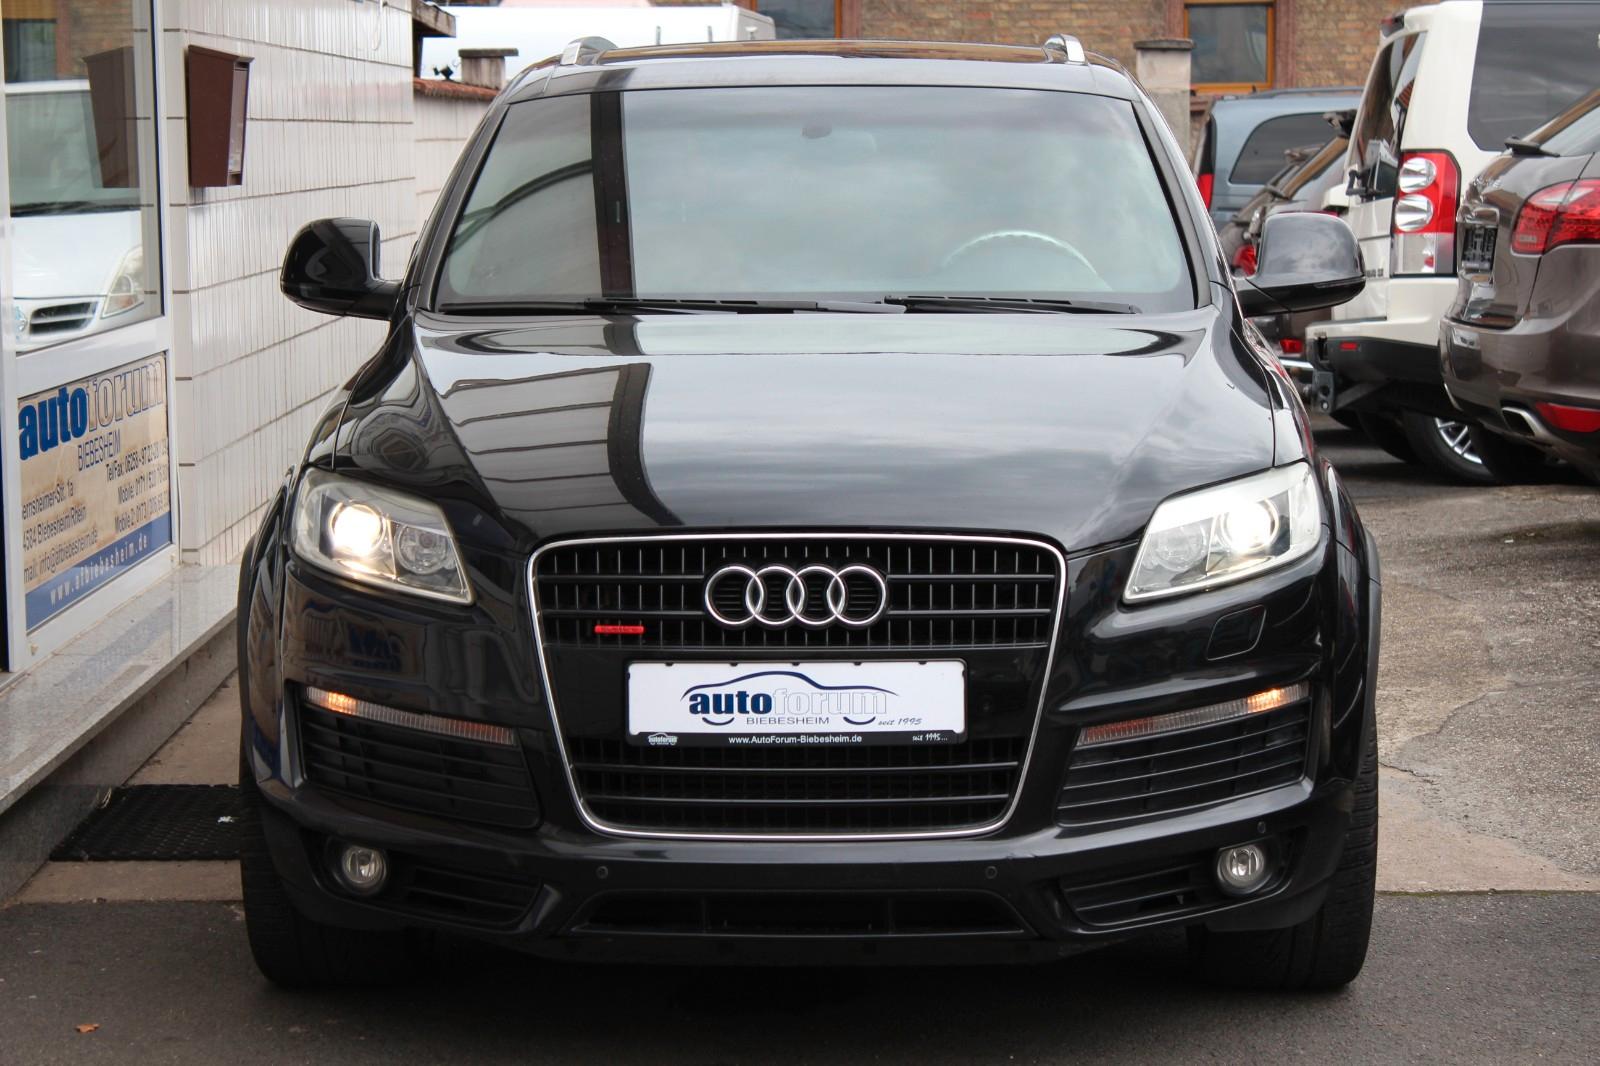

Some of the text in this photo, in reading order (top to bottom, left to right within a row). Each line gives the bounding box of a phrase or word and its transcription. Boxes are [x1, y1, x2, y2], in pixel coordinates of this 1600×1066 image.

[18, 360, 164, 460] autoforum
[77, 429, 120, 471] BIEBESHEIM
[51, 533, 147, 608] www.afbiebesheim.de
[689, 688, 887, 715] autoforum
[746, 717, 829, 725] BIEBESHEIM
[898, 717, 922, 725] 1995
[728, 734, 863, 744] www.AutoForum-Biebesheim.de
